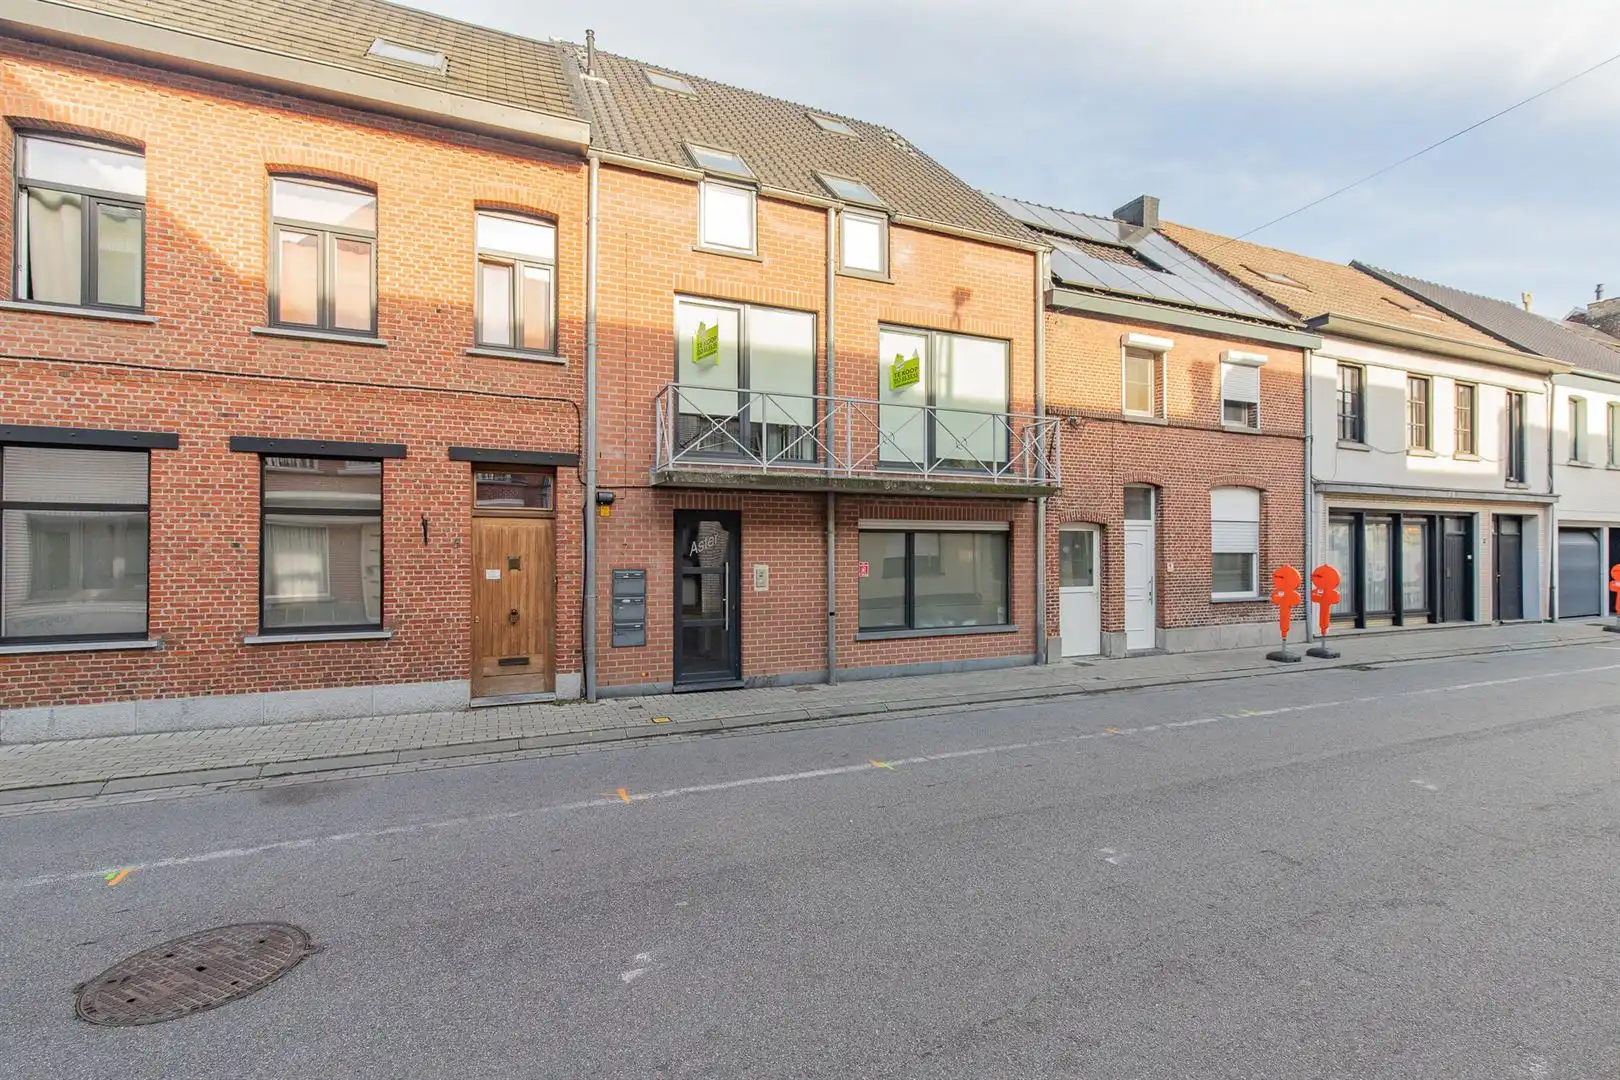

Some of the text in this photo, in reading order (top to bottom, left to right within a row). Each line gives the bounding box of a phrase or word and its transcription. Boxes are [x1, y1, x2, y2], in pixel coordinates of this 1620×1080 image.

[703, 335, 718, 346] KOOP
[894, 371, 901, 379] TE
[901, 366, 918, 376] KOOP
[689, 531, 719, 557] Aster
